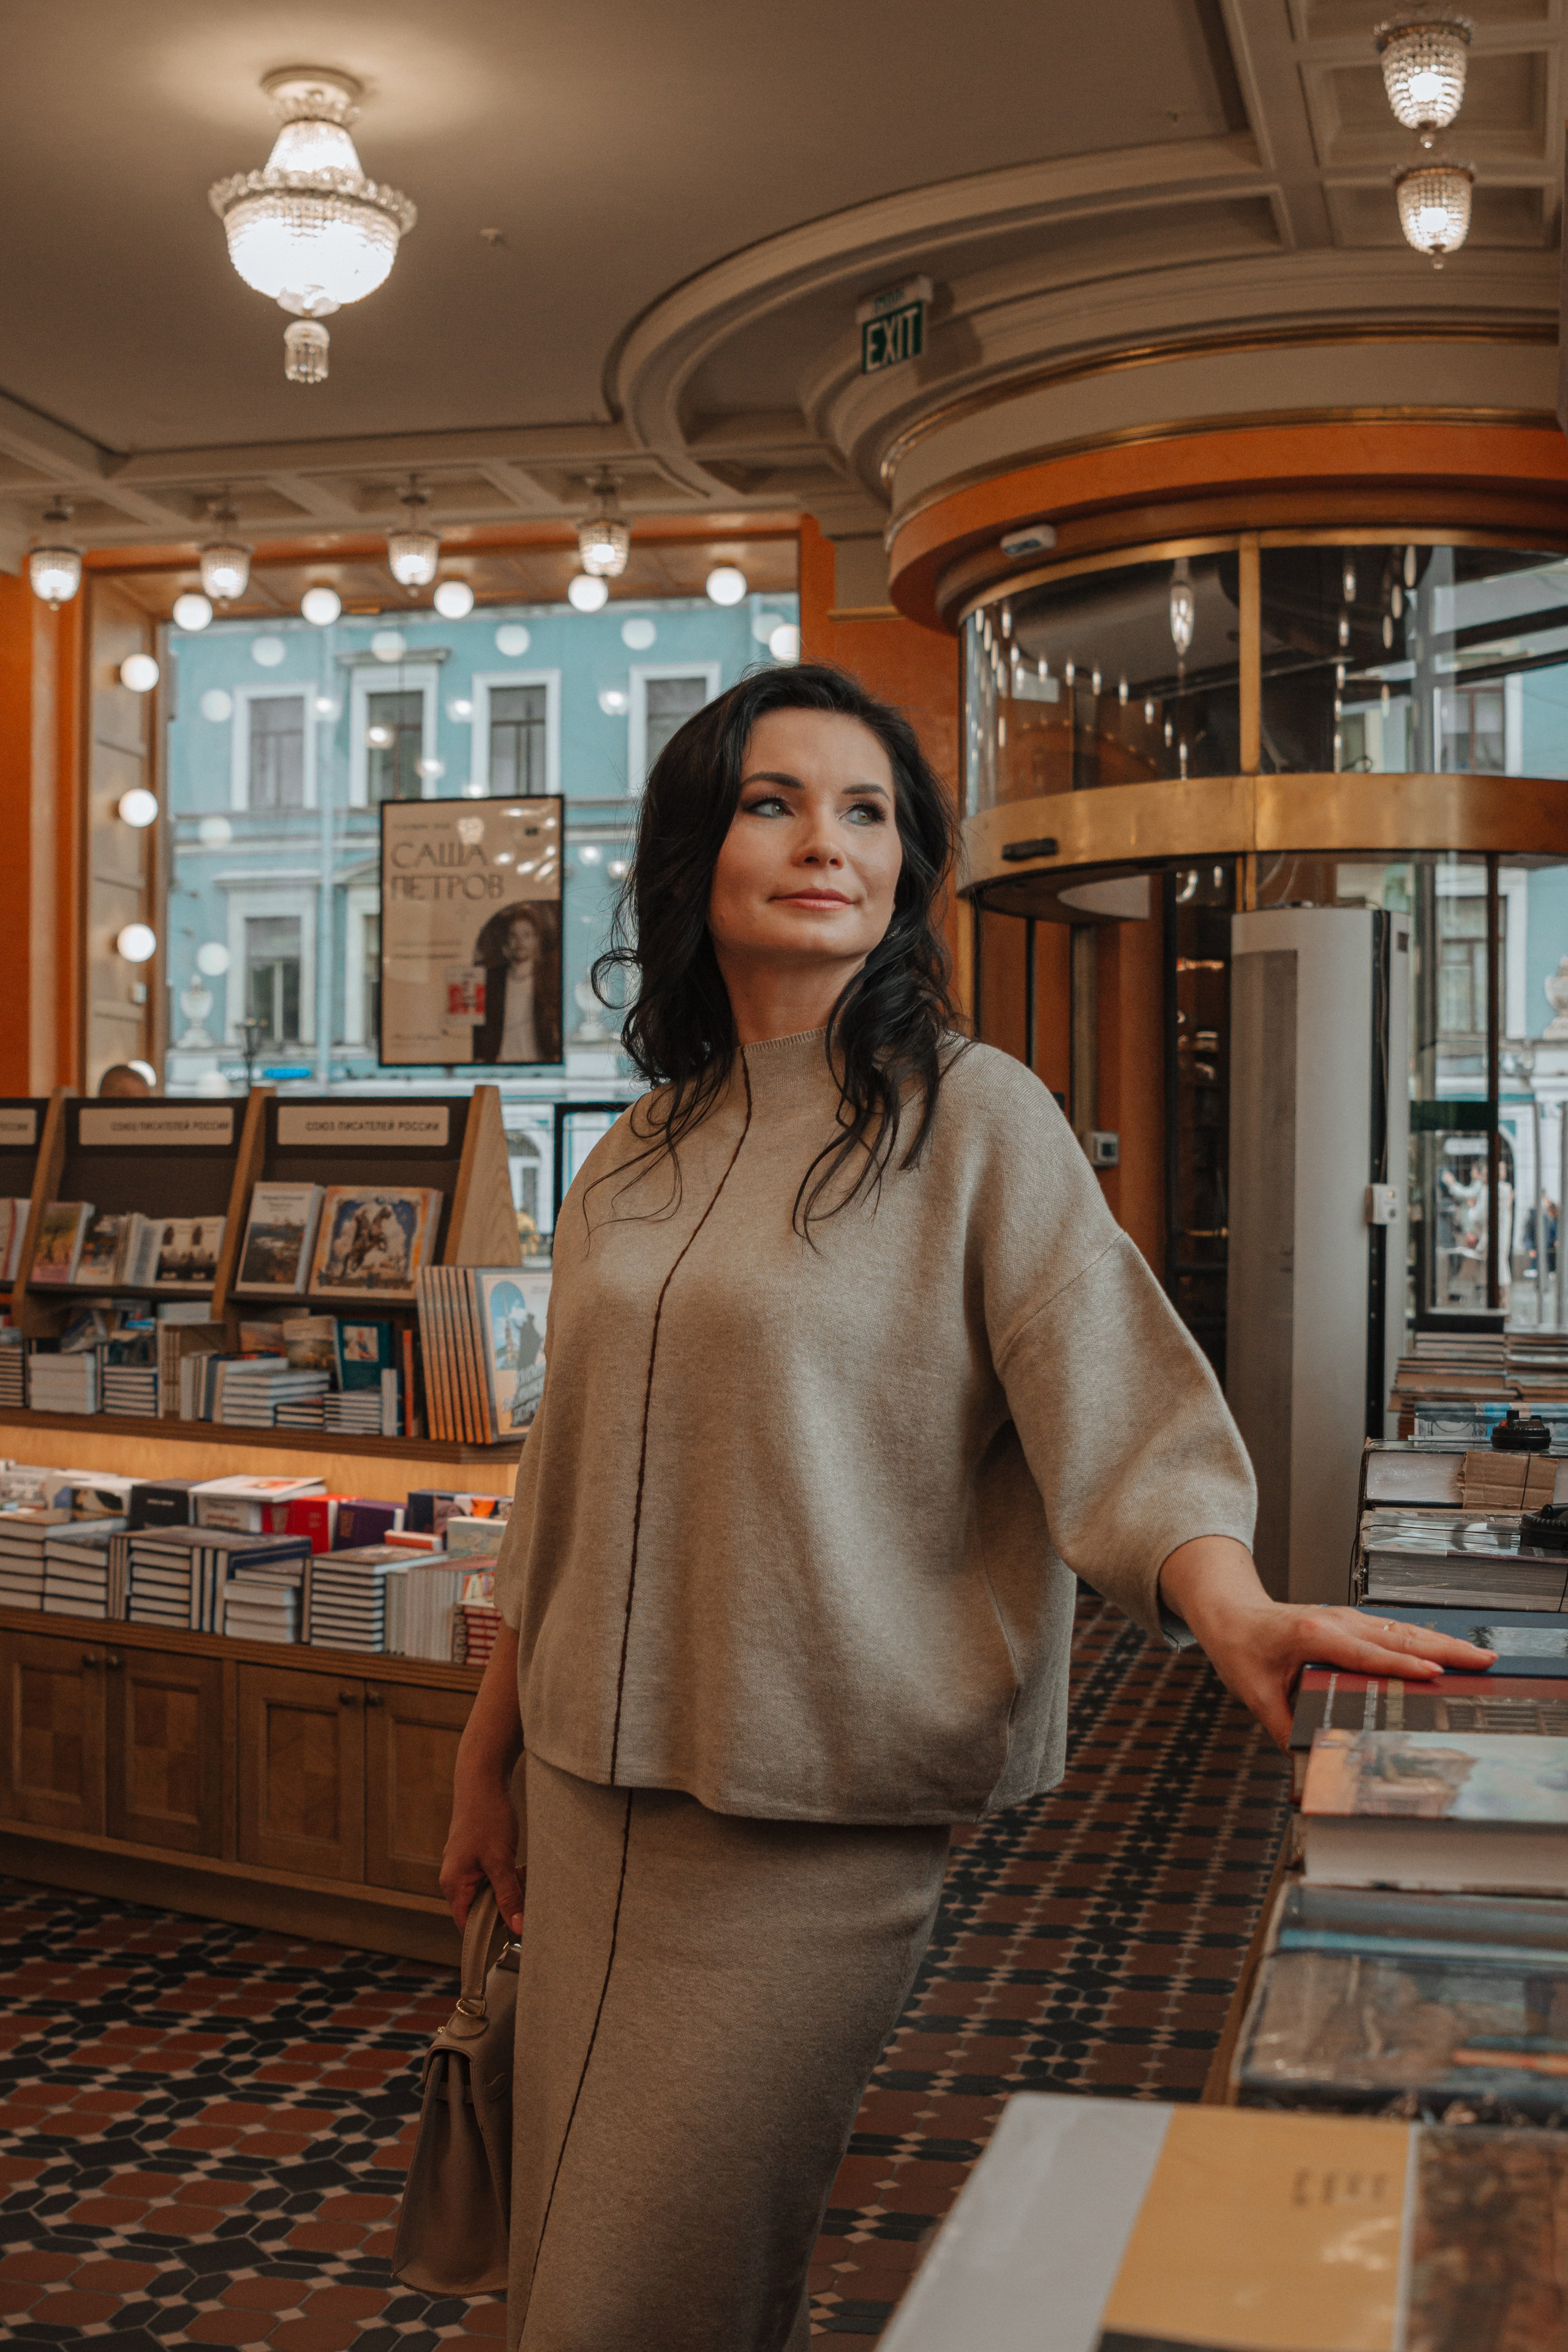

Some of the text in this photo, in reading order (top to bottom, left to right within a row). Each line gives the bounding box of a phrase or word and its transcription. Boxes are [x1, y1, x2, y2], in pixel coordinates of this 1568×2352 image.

[867, 307, 918, 371] EXIT
[391, 842, 489, 869] САША
[391, 873, 504, 900] ПЕТРОВ
[306, 1120, 439, 1131] СОЮЗ ПИСАТЕЛЕЙ РОССИИ
